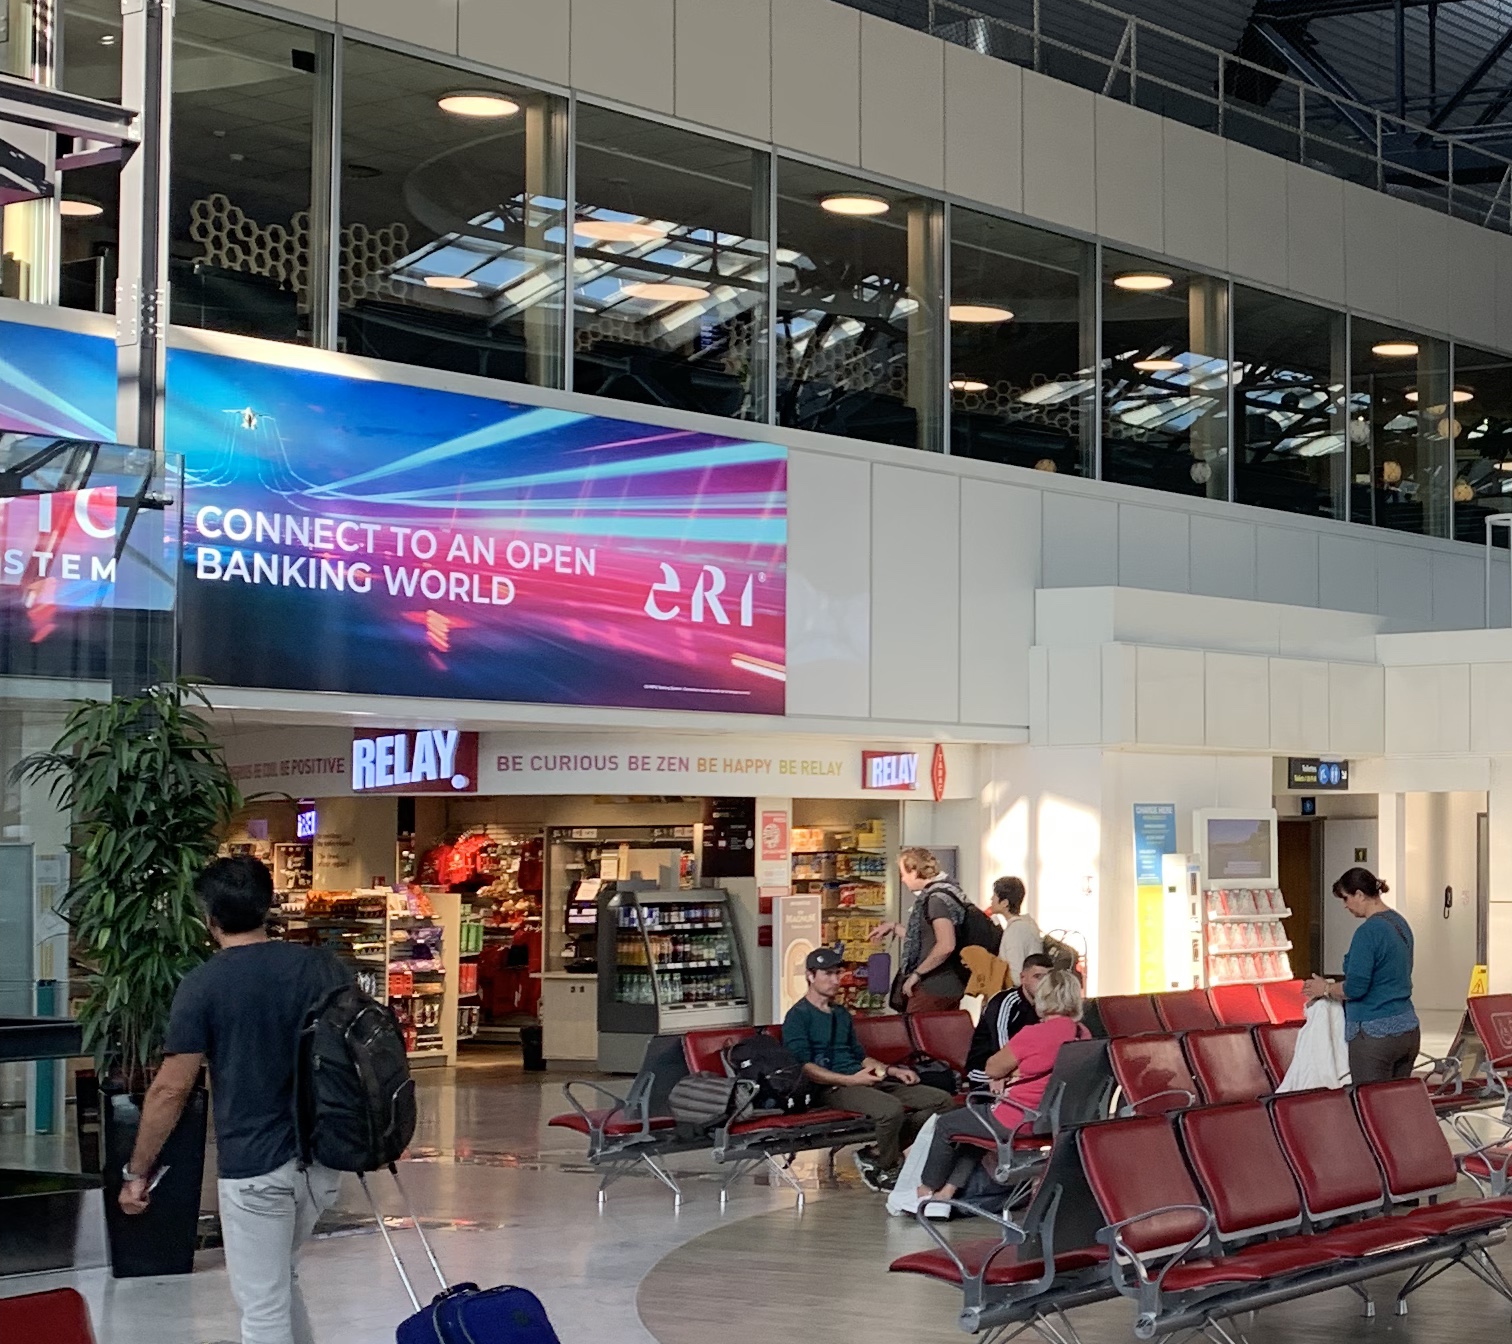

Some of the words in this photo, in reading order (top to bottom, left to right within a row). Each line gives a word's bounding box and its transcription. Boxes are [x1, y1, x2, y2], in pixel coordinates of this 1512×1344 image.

[196, 505, 381, 554] CONNECT
[390, 526, 437, 560] TO
[446, 533, 495, 566] AN
[506, 540, 595, 576] OPEN
[196, 546, 372, 594] BANKING
[383, 565, 516, 606] WORLD
[291, 757, 346, 776] POSITIVE
[496, 755, 523, 771] BE
[530, 755, 619, 771] CURIOUS
[627, 755, 652, 771] BE
[656, 756, 690, 772] ZEN
[697, 757, 718, 773] BE
[723, 758, 772, 774] HAPPY
[779, 759, 797, 775] BE
[801, 760, 843, 776] RELAY
